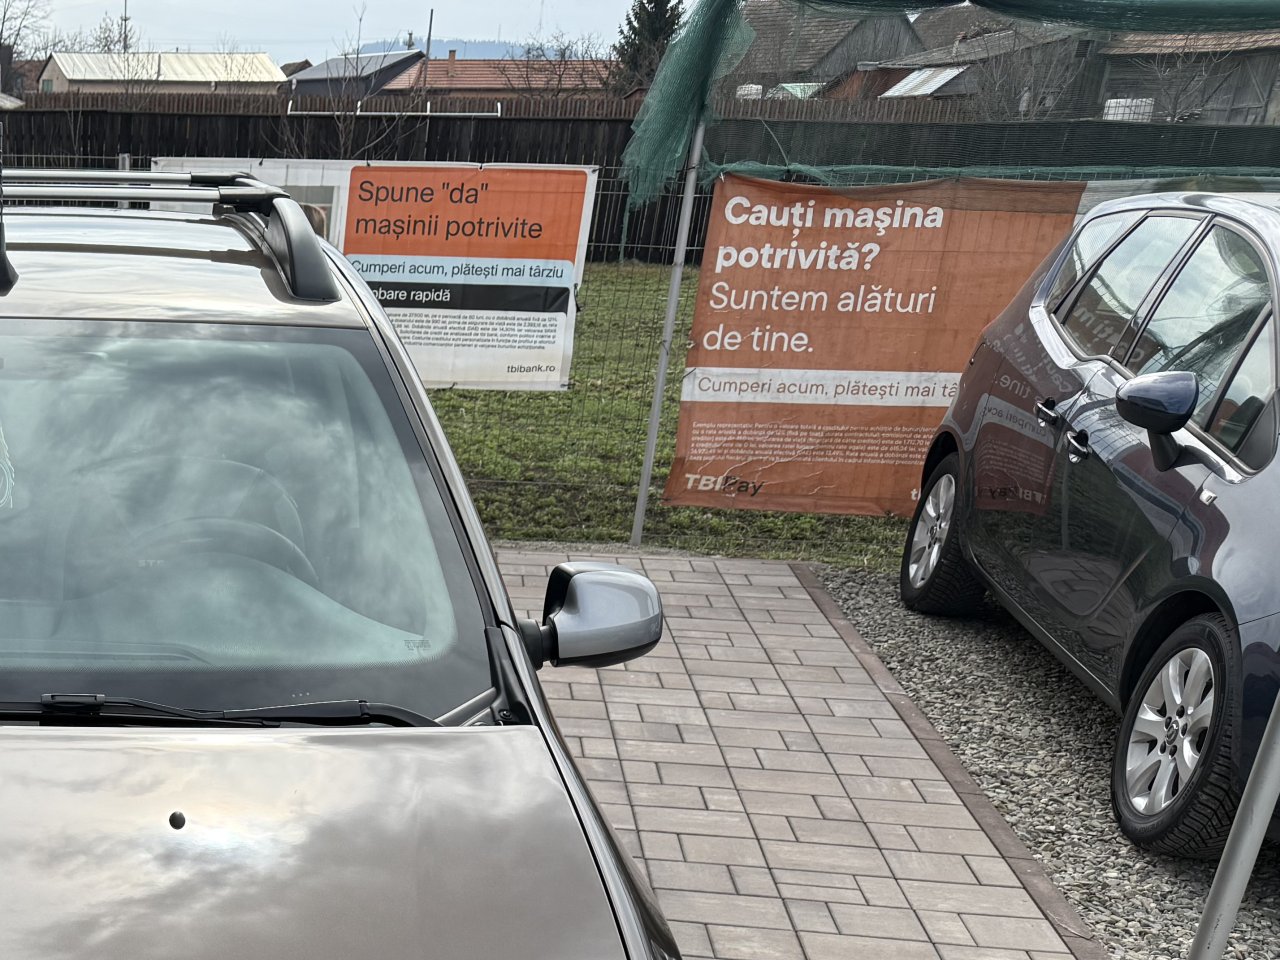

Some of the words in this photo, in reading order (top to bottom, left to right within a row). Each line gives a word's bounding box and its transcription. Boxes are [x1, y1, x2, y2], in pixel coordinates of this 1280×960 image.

[358, 180, 434, 205] Spune
[442, 182, 489, 204] "da"
[355, 215, 439, 240] mașinii
[445, 216, 543, 241] potrivite
[724, 195, 816, 239] Cauți
[714, 240, 881, 273] potrivită?
[351, 260, 406, 276] Cumperi
[409, 264, 448, 277] acum,
[451, 263, 499, 279] plătești
[501, 265, 525, 278] mai
[527, 264, 564, 279] târziu
[410, 289, 451, 303] rapidă
[709, 281, 828, 312] Suntem
[837, 284, 937, 313] alături
[702, 324, 742, 351] de
[751, 325, 814, 353] tine.
[506, 364, 556, 374] tbibank.ro
[698, 376, 772, 397] Cumperi
[776, 381, 829, 398] acum,
[904, 382, 937, 398] mai
